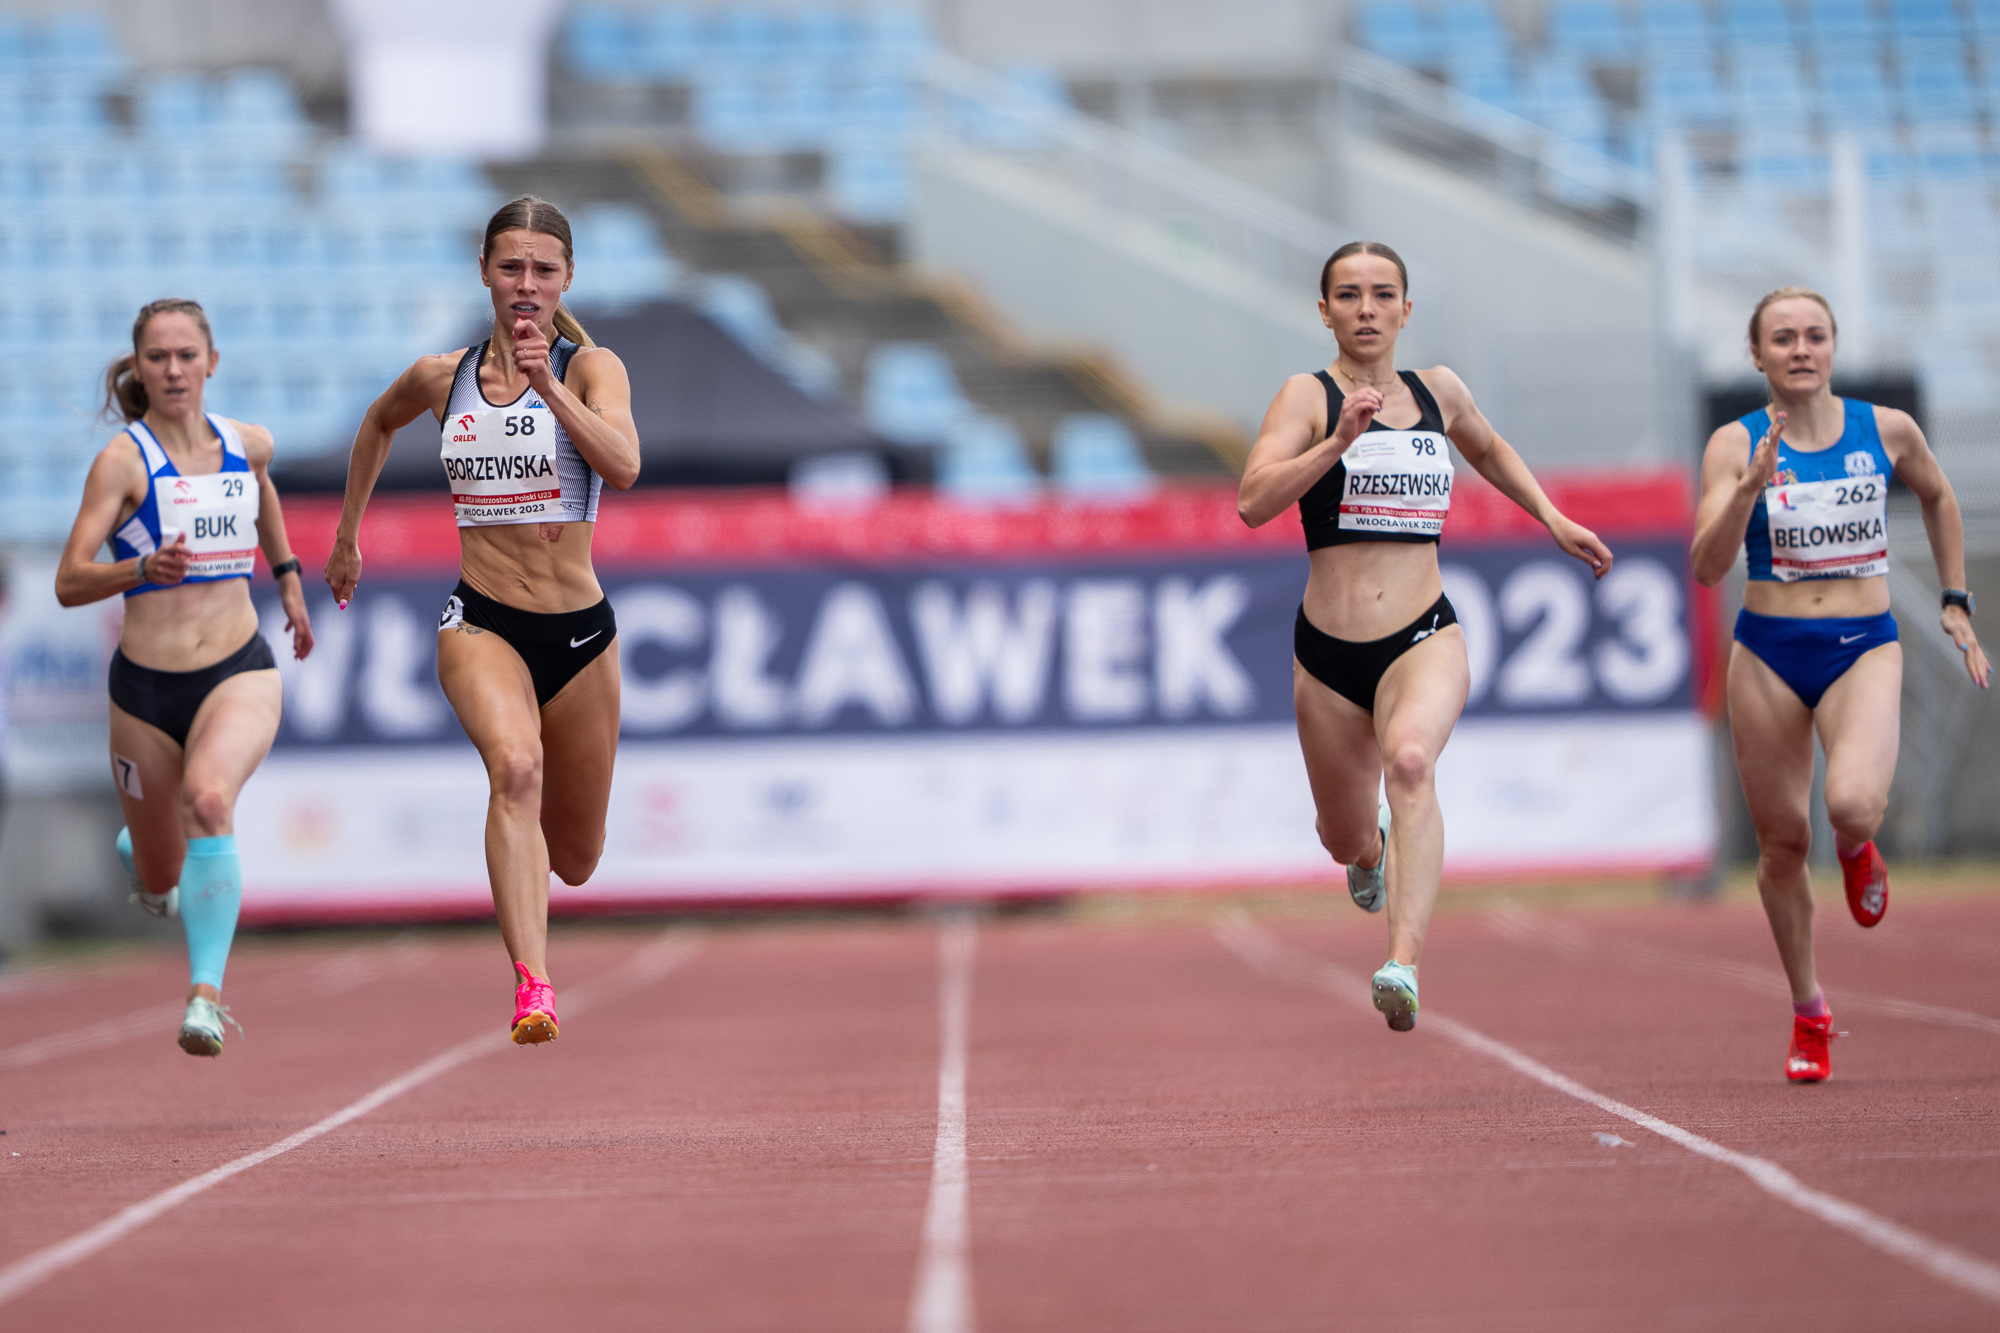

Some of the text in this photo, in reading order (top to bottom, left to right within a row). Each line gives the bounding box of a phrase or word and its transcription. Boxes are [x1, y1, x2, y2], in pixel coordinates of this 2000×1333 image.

[505, 415, 535, 436] 58
[453, 434, 477, 443] ORLEN
[1411, 437, 1436, 456] 98
[445, 454, 553, 481] BORZEWSKA
[222, 478, 243, 497] 29
[1349, 473, 1450, 496] RZESZEWSKA
[1836, 483, 1877, 506] 262
[475, 496, 513, 504] Mistrzostwa
[514, 493, 537, 502] Polski
[537, 491, 552, 499] U23
[463, 503, 545, 516] WŁOCŁAWEK 2023
[1379, 507, 1417, 517] Mistrzostwa
[1418, 510, 1437, 518] Polski
[195, 514, 237, 539] BUK
[1355, 517, 1440, 530] WŁOCŁAWEK 2023
[1774, 517, 1883, 548] BELOWSKA
[264, 574, 1254, 738] WŁCŁAWEK
[117, 758, 131, 790] 7
